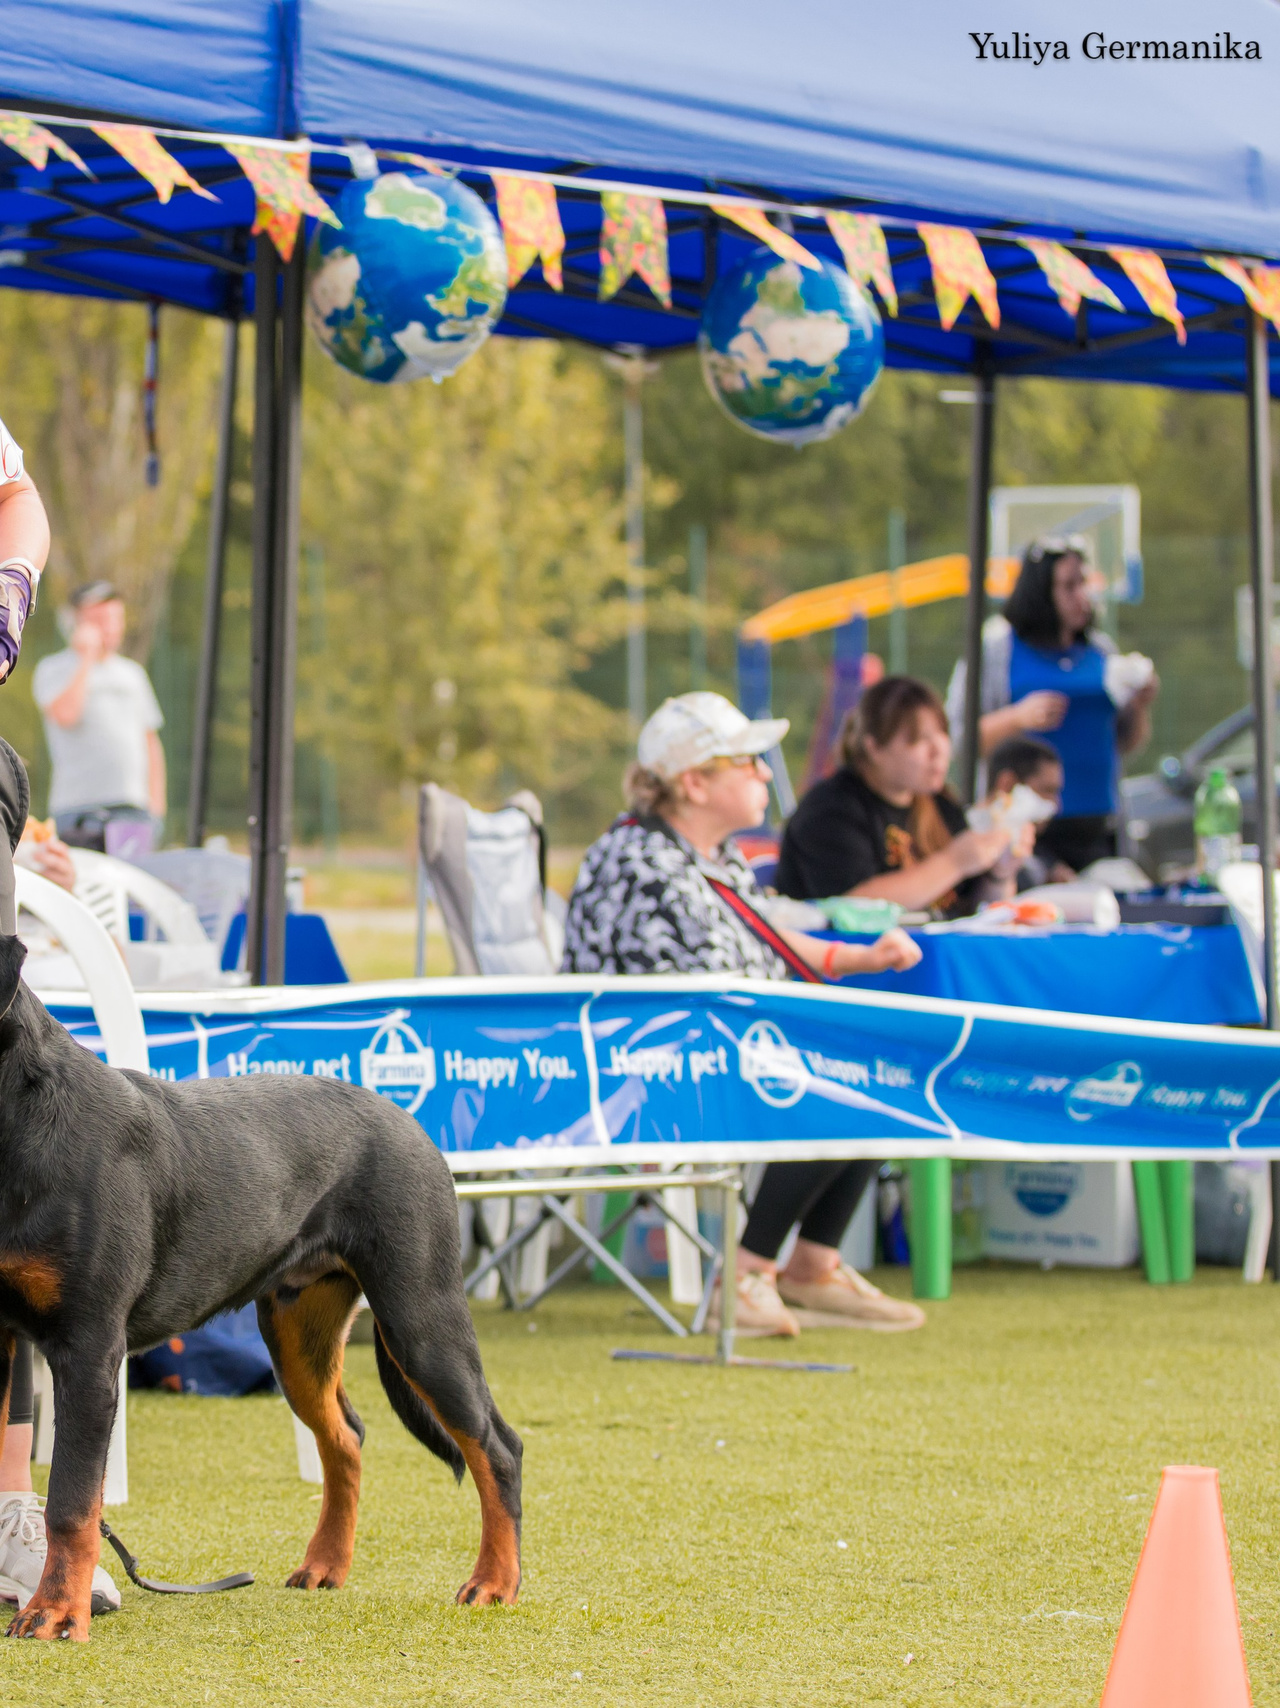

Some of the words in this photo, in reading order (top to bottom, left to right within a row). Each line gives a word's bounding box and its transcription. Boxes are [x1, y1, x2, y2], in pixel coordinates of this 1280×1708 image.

[443, 1049, 519, 1089] Happy
[522, 1047, 577, 1080] You.
[610, 1045, 684, 1083] Happy
[688, 1045, 728, 1082] pet
